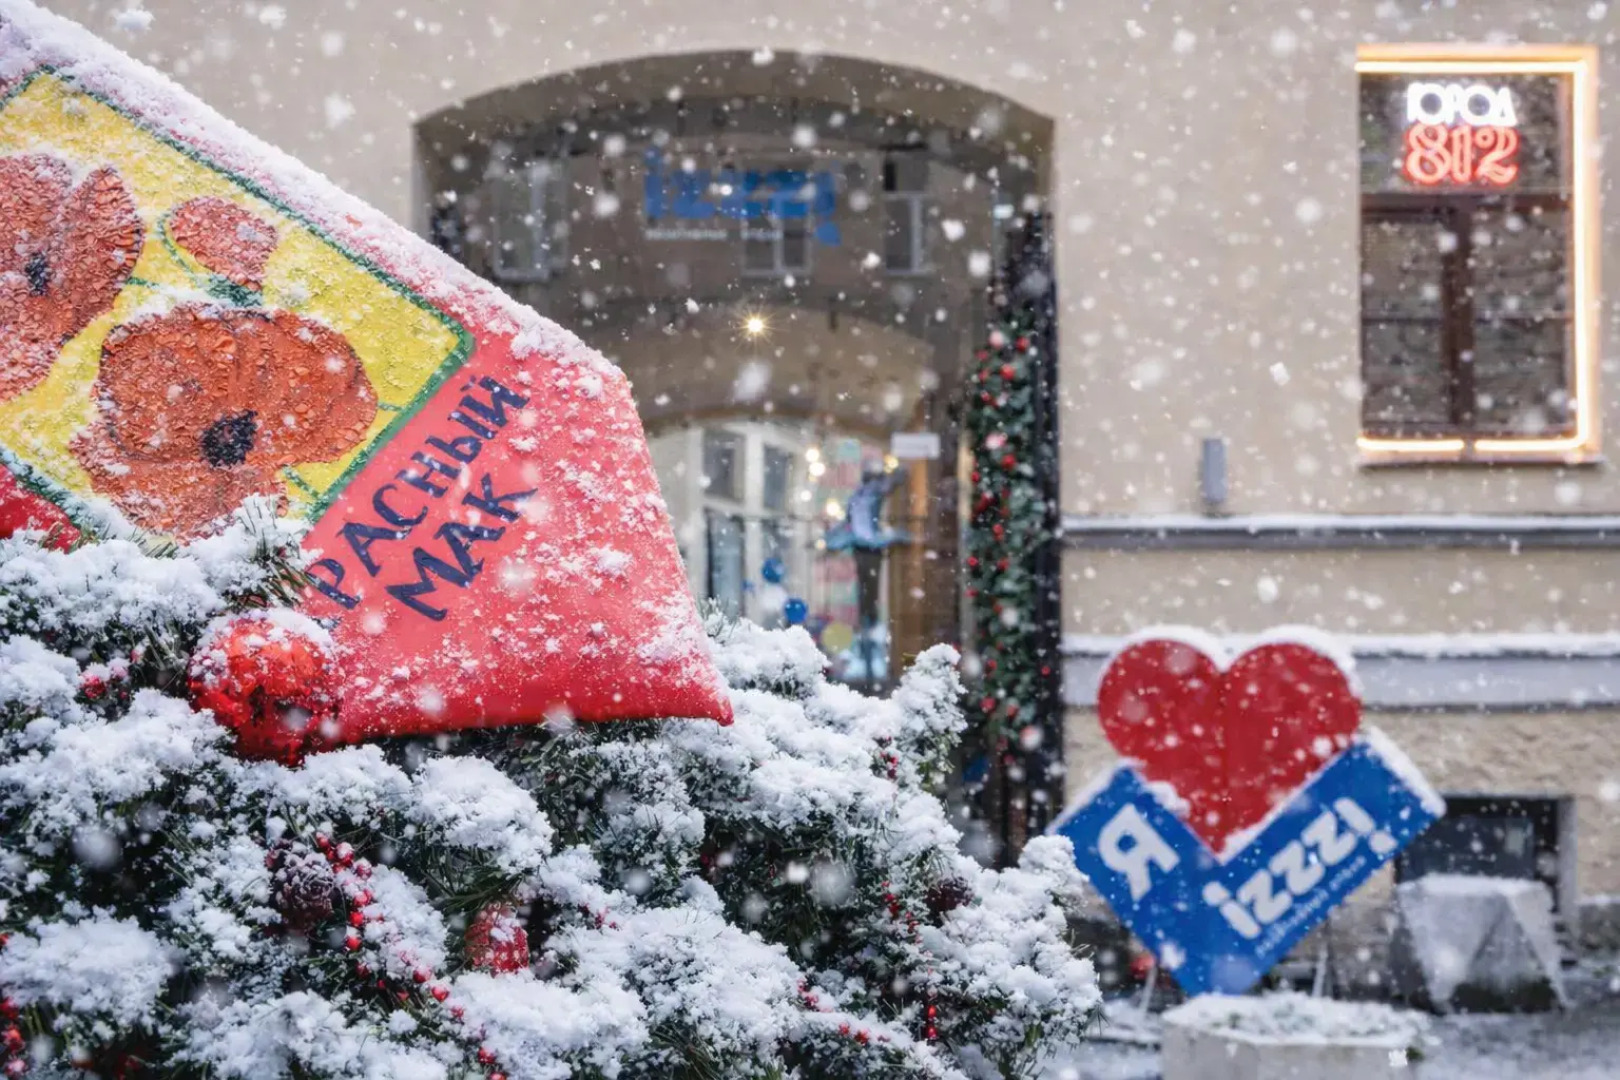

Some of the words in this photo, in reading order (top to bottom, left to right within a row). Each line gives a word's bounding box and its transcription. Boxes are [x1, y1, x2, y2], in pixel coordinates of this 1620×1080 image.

[1405, 122, 1518, 185] 812
[302, 375, 530, 629] РАСНЫЙ
[384, 472, 539, 622] МАК
[1098, 803, 1180, 901] Я
[1202, 797, 1397, 939] izzz!
